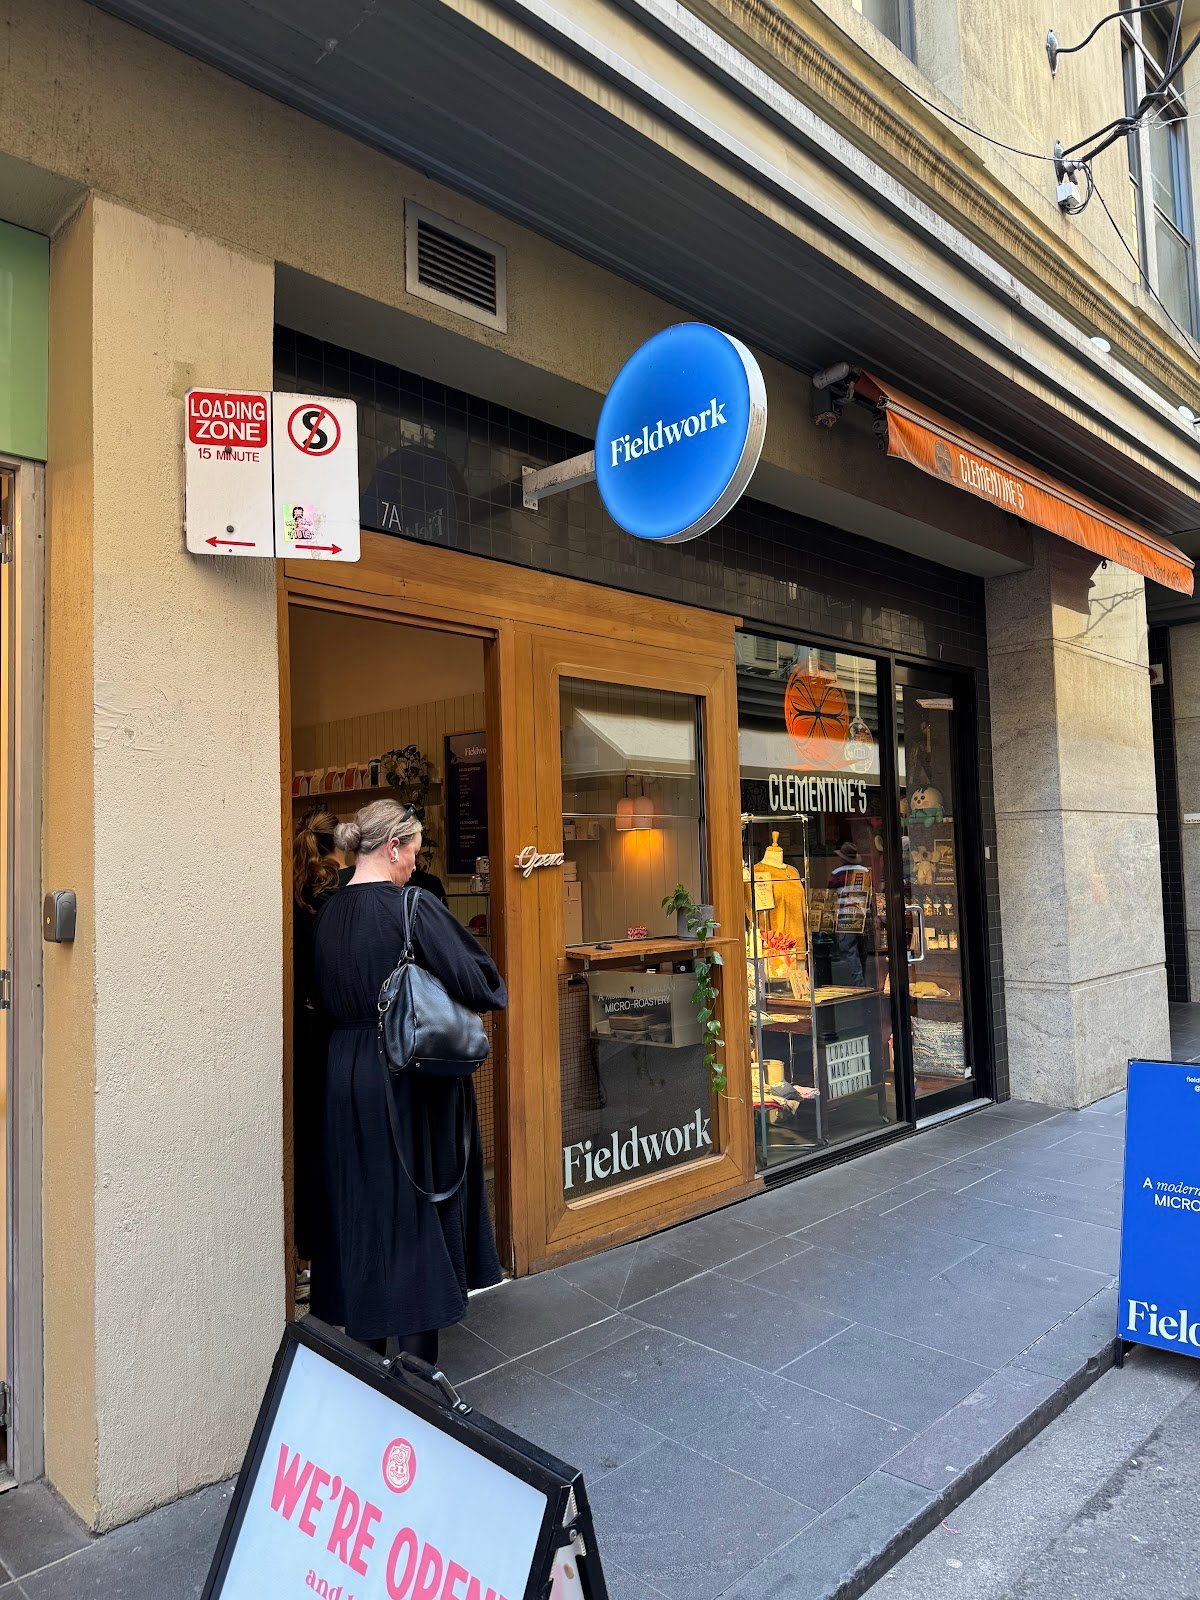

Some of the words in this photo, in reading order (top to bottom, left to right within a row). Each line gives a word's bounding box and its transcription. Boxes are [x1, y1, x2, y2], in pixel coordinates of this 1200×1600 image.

[191, 398, 265, 421] LOADING
[196, 419, 262, 442] ZONE
[610, 397, 728, 468] Fieldwork
[198, 447, 212, 460] 15
[216, 450, 260, 463] MINUTE
[960, 453, 1024, 511] CLEMENTINE'S
[381, 501, 402, 531] 7A
[768, 773, 867, 815] CLEMENTINE'S
[514, 846, 565, 879] Open
[604, 994, 671, 1014] MICRO-ROASTERY
[829, 1039, 864, 1062] LOCALLY
[831, 1060, 850, 1079] MADE
[857, 1057, 866, 1073] IN
[829, 1074, 870, 1099] VICTORIA
[562, 1107, 713, 1190] Fieldwork
[1142, 1176, 1153, 1190] A
